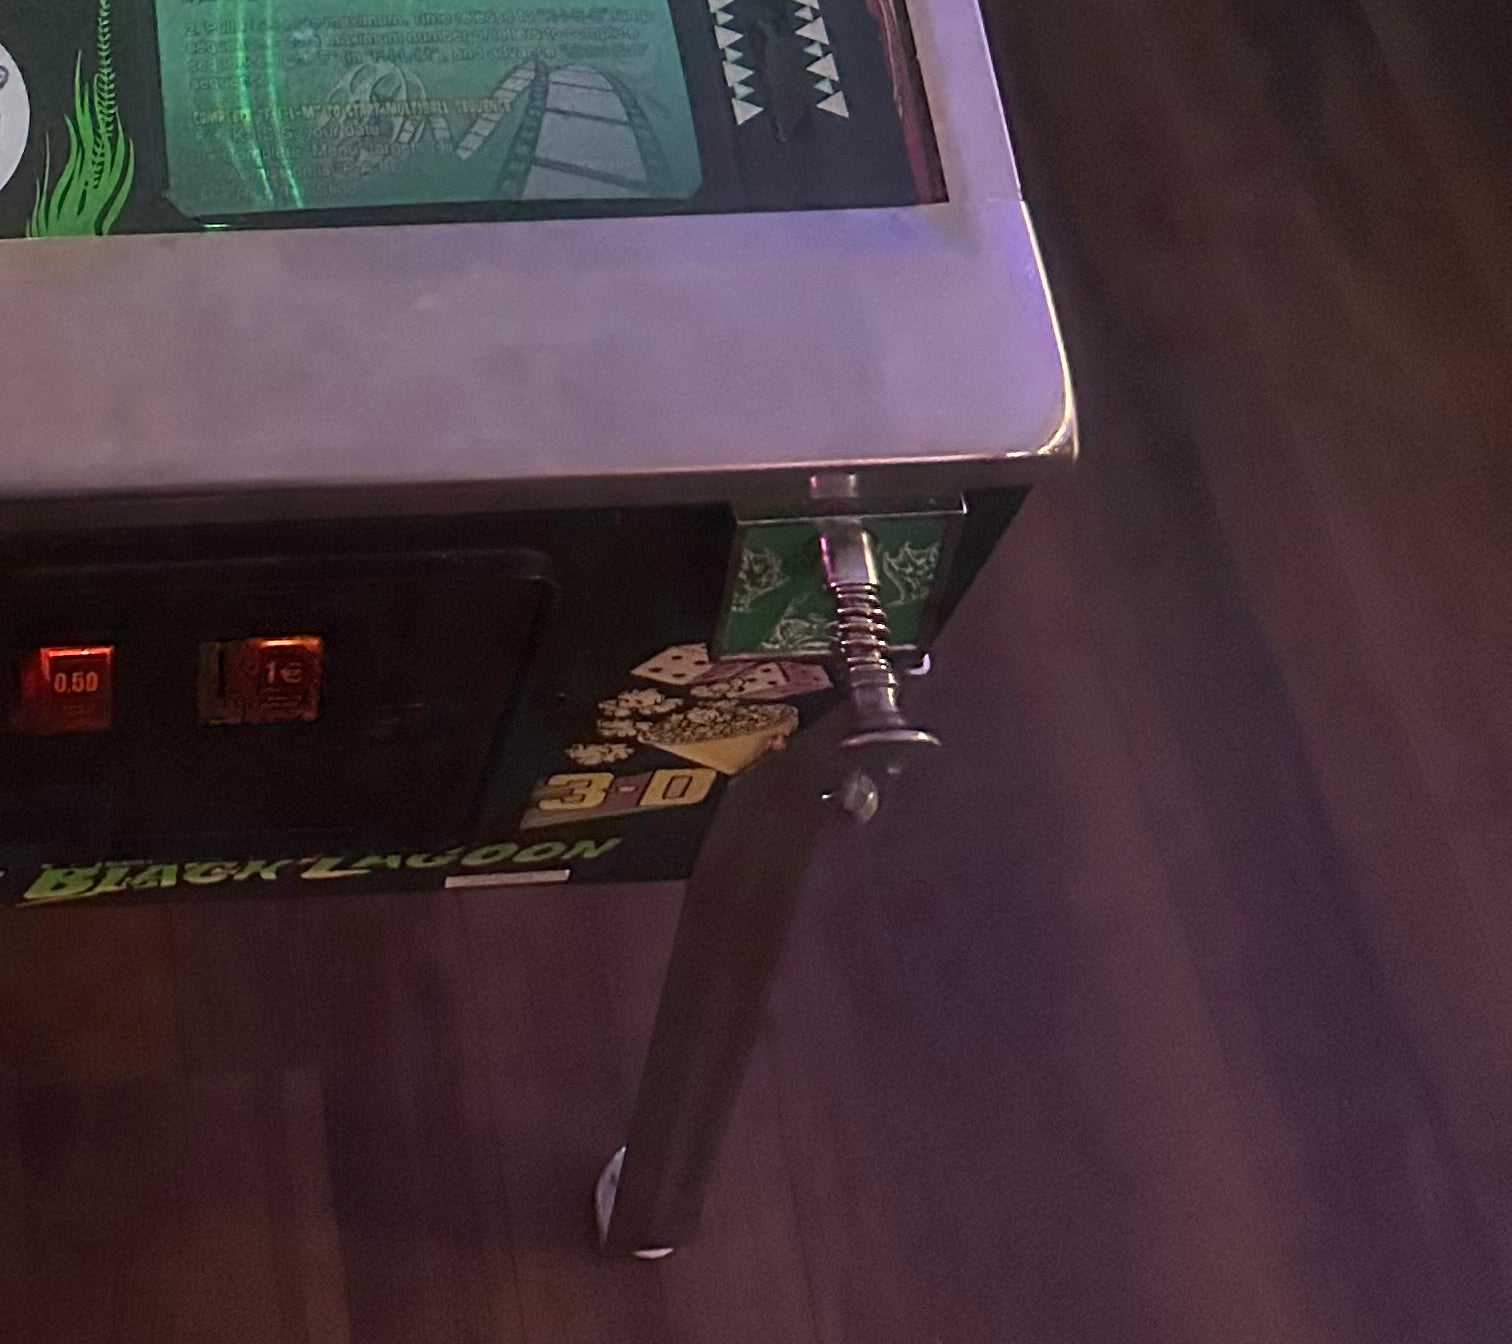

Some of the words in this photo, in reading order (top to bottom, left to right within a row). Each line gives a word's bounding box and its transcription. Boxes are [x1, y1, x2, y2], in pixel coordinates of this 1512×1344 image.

[53, 671, 99, 694] 0.50
[533, 767, 718, 812] 3-D
[21, 856, 296, 902] BLACK
[299, 837, 624, 880] LAGOON
